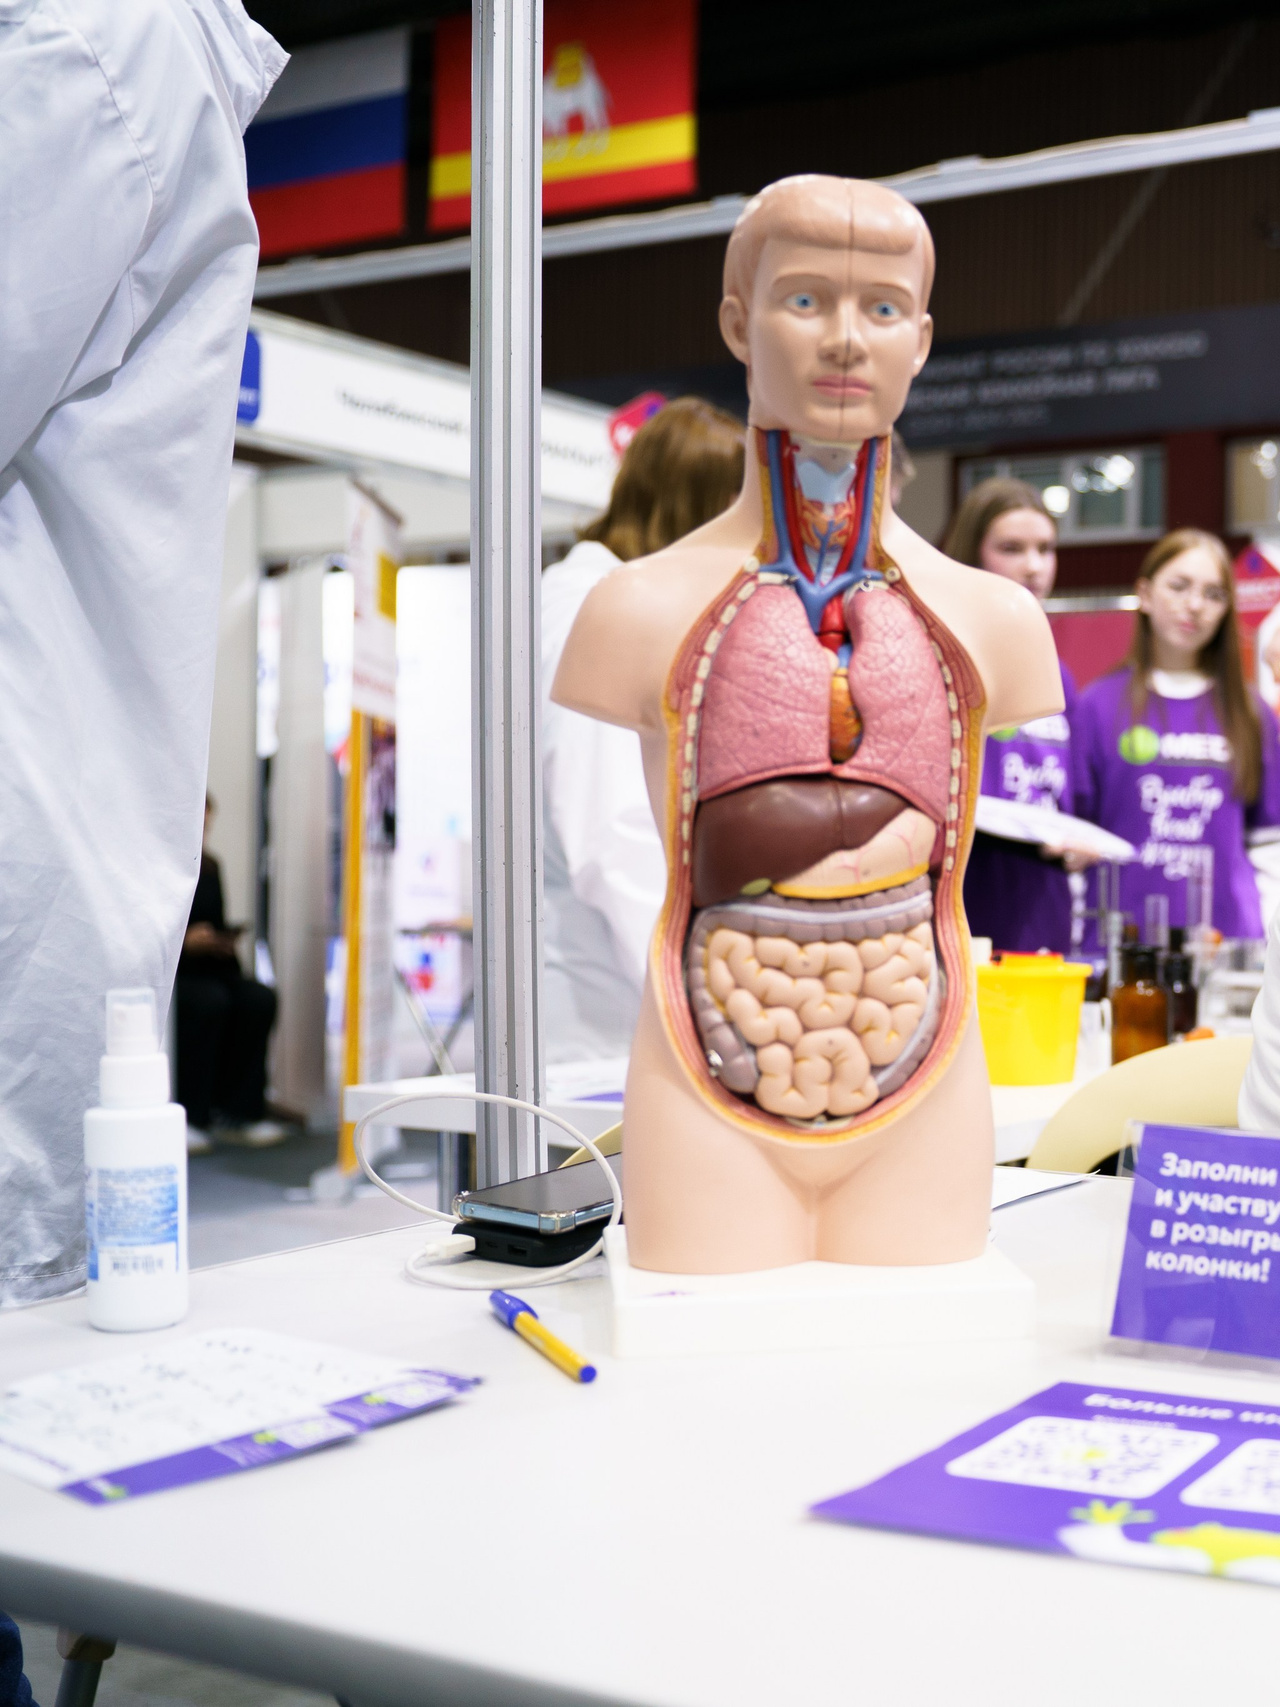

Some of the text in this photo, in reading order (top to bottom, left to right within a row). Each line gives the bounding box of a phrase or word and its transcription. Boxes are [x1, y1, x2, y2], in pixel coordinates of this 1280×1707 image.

[1159, 1152, 1278, 1187] Заполни
[1154, 1188, 1174, 1207] и
[1150, 1219, 1167, 1238] в
[1145, 1250, 1272, 1284] колонки!
[1083, 1393, 1234, 1420] Больше
